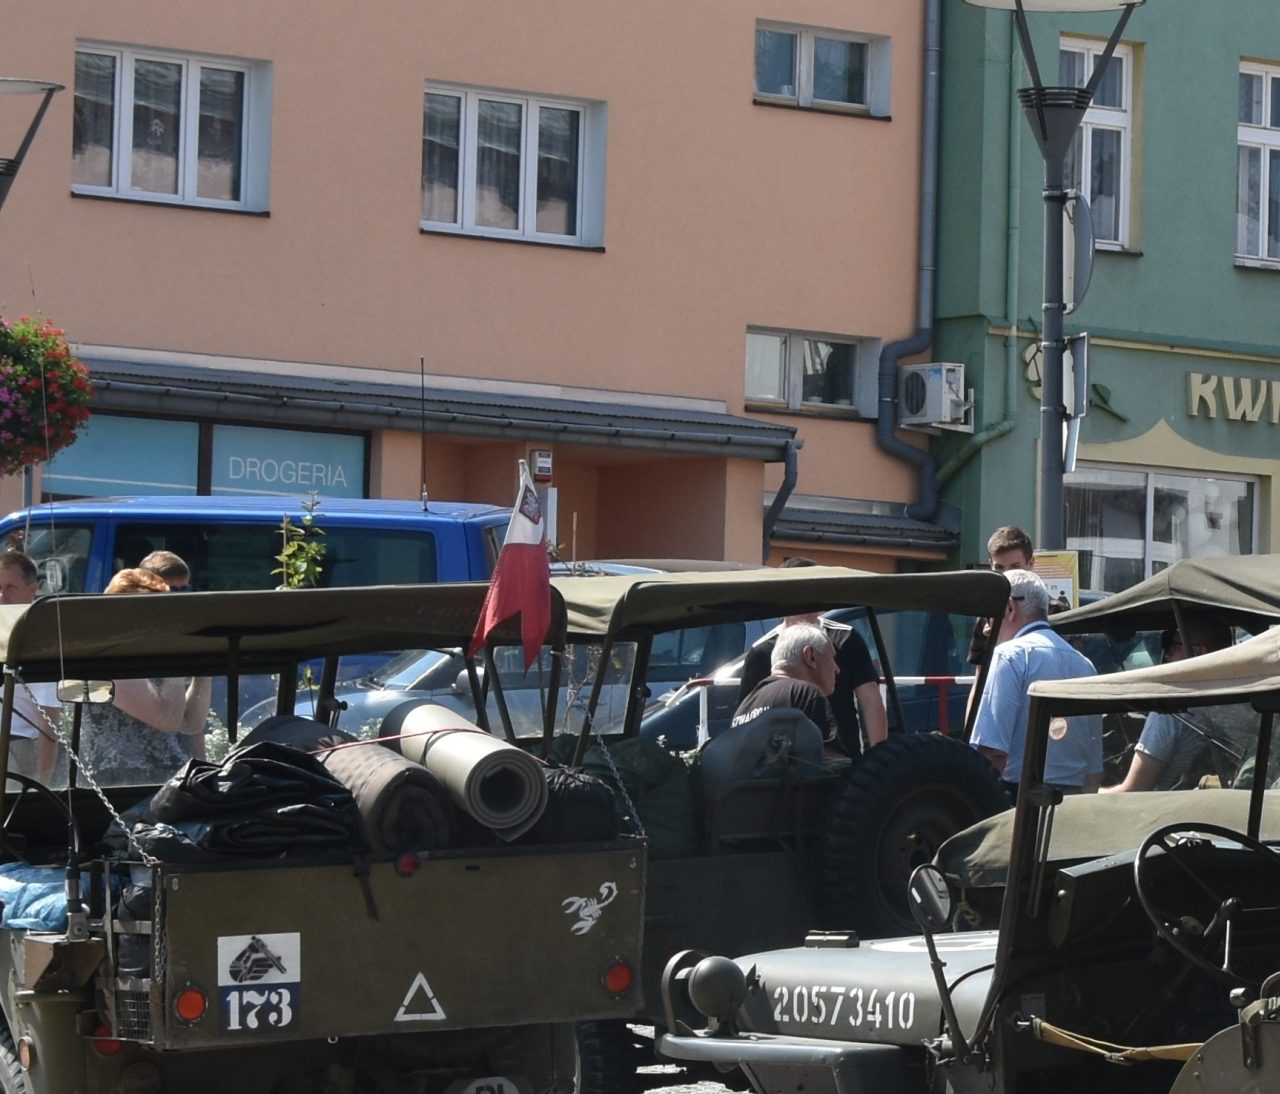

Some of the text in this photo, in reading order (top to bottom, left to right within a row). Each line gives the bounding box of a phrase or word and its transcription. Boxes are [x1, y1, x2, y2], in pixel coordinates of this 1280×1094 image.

[229, 456, 348, 487] DROGERIA
[225, 988, 293, 1031] 173
[773, 985, 915, 1030] 20573410
